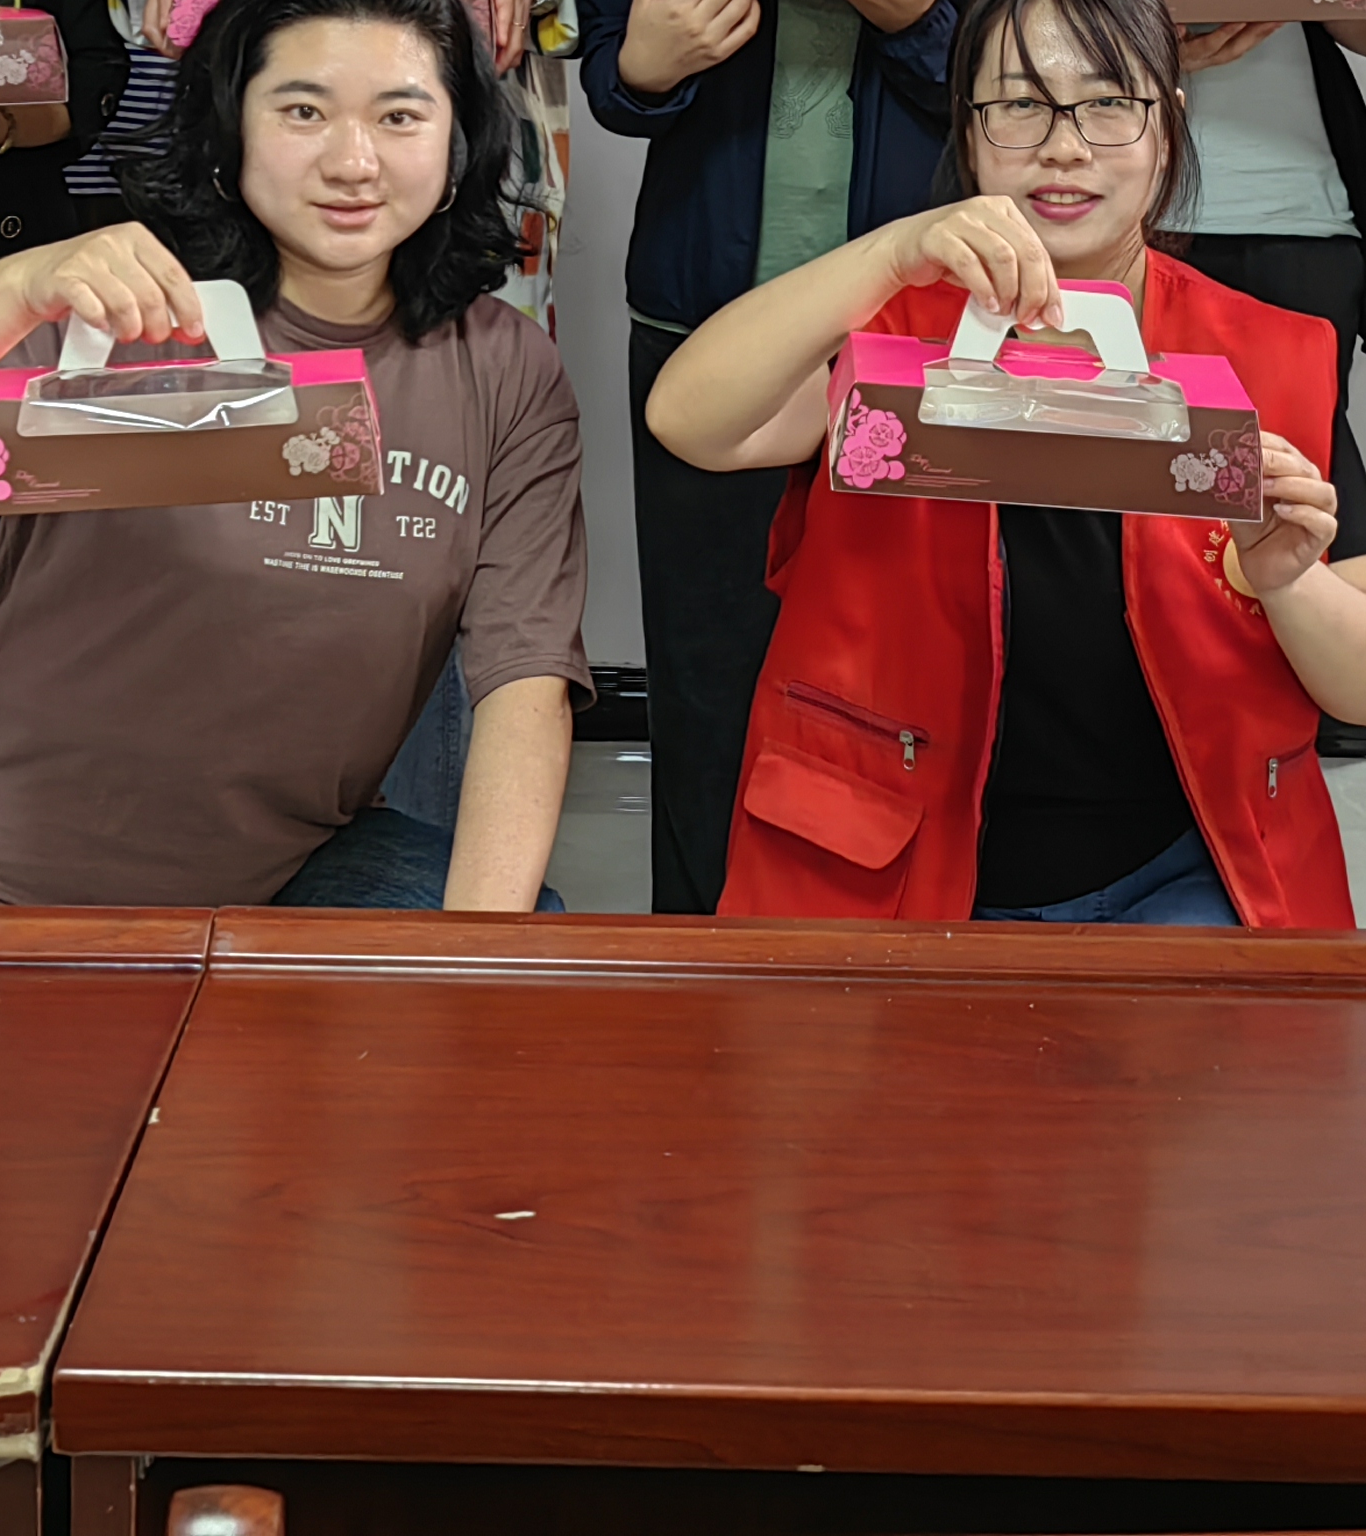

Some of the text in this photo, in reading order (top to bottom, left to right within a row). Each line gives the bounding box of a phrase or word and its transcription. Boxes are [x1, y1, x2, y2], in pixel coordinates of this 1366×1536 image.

[387, 450, 470, 515] TION
[249, 501, 291, 526] EST
[308, 496, 364, 552] N
